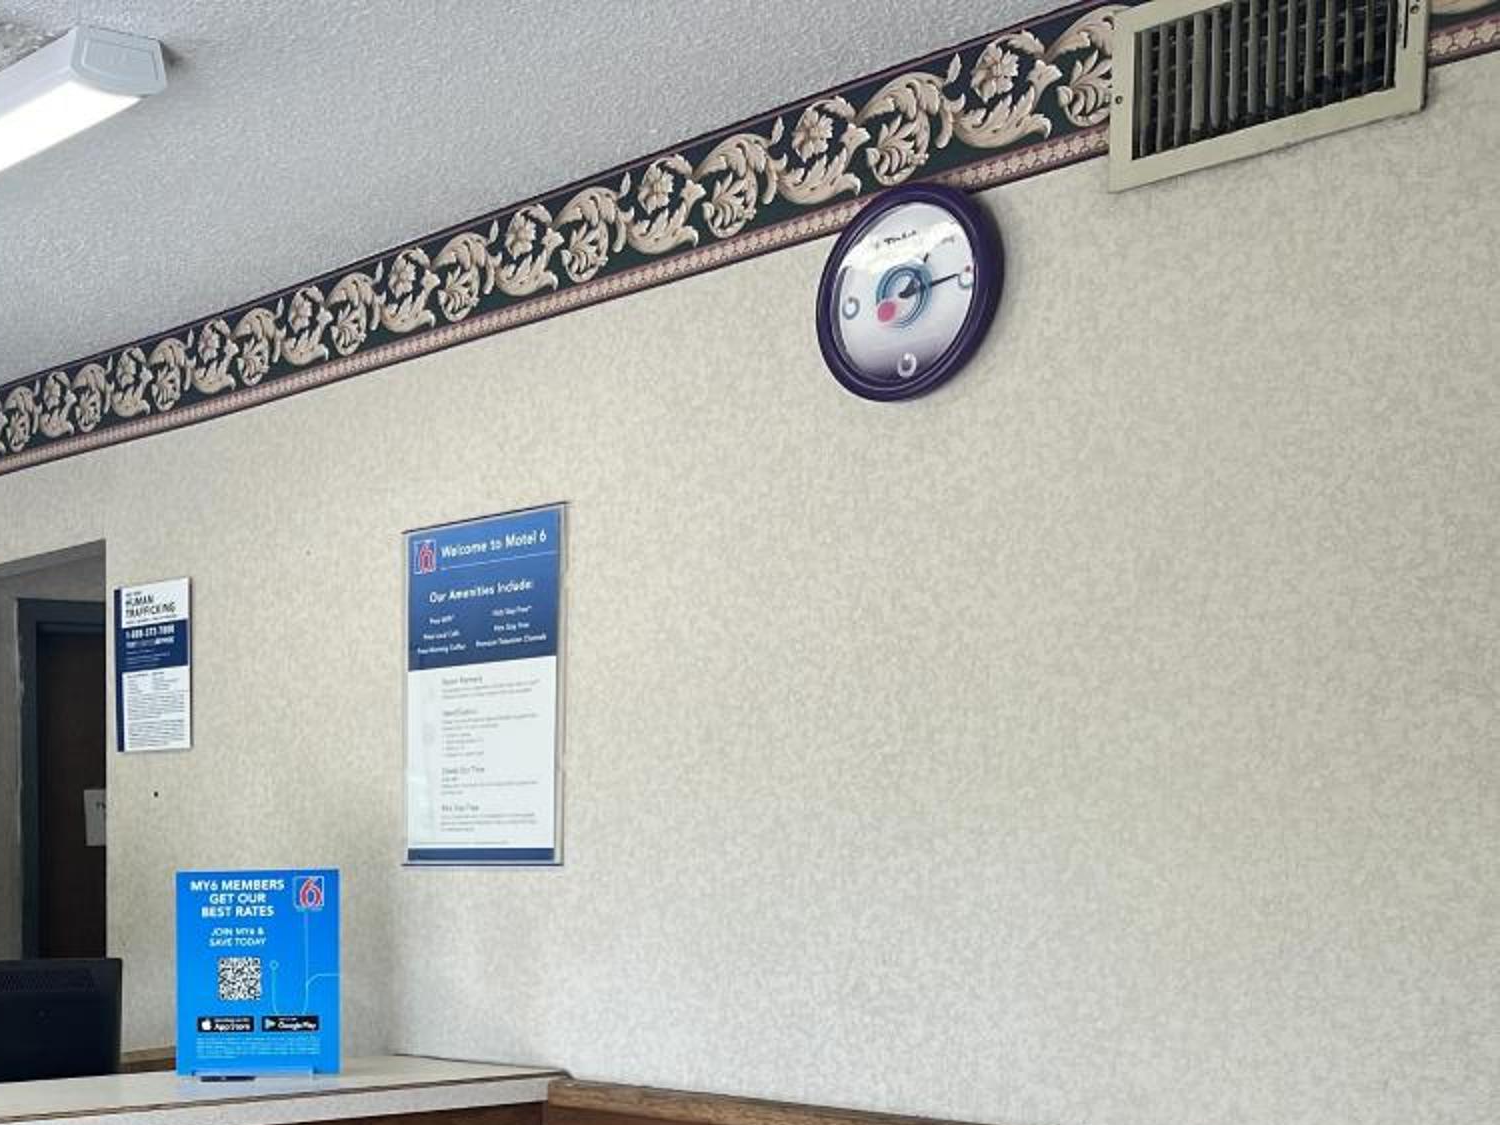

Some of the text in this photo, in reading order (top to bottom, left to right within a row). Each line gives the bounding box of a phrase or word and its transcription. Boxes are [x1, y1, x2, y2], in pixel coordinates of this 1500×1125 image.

[441, 529, 548, 559] Welcome to Motel 6
[125, 594, 154, 606] HUMAN
[429, 592, 446, 603] Our
[449, 585, 494, 600] Amenities
[125, 602, 176, 617] TRAFFICKING
[190, 878, 285, 892] MY6 MEMBERS
[209, 892, 267, 905] GET OUR
[201, 905, 275, 918] BEST RATES
[211, 928, 233, 937] JOIN
[209, 937, 267, 947] SAVE TODAY
[278, 1021, 302, 1031] Google
